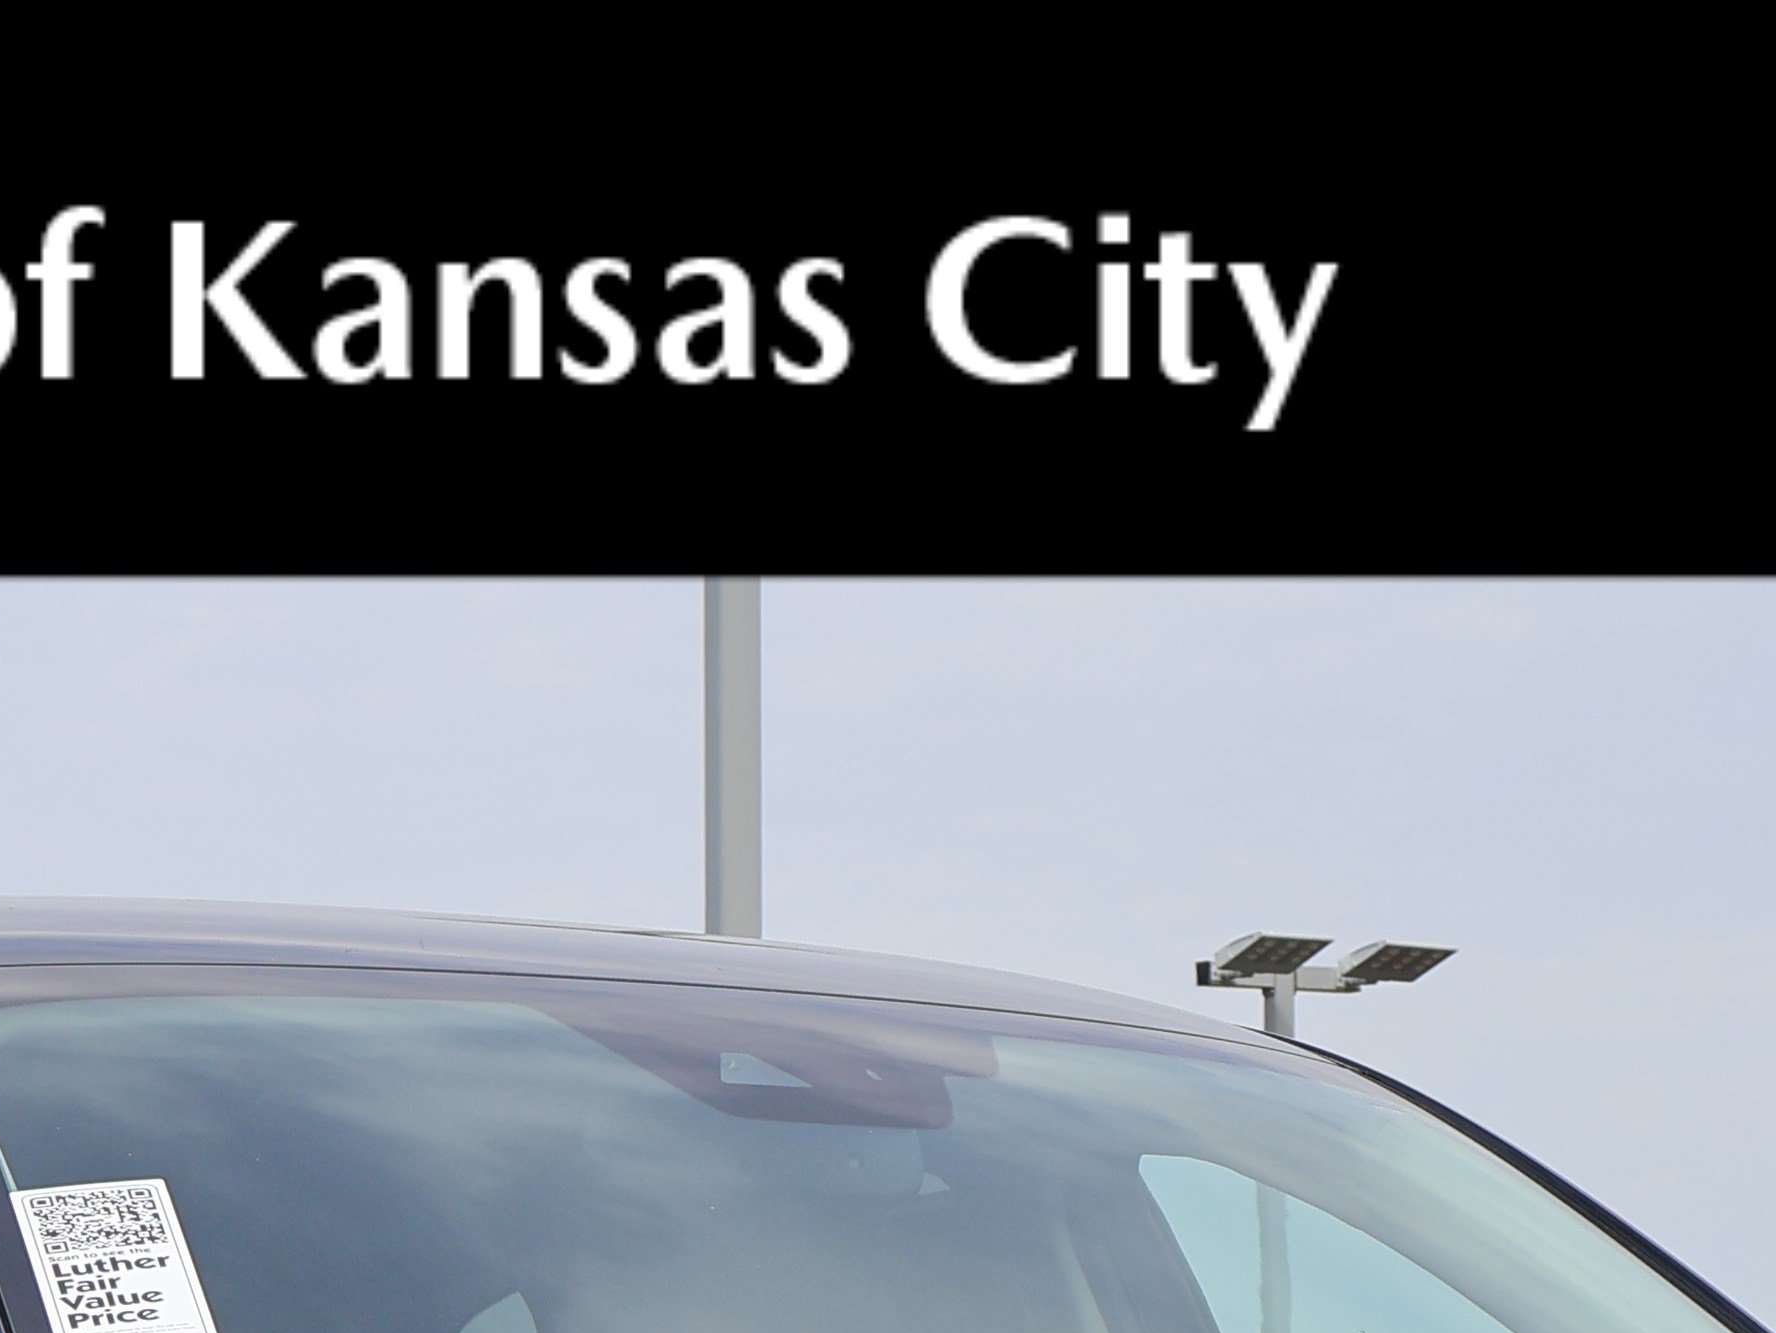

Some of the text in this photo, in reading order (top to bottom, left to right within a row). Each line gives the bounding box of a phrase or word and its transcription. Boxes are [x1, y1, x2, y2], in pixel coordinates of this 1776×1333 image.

[48, 1254, 79, 1263] Scan
[51, 1255, 170, 1278] Luther
[56, 1274, 121, 1295] Fair
[59, 1290, 165, 1311] Value
[67, 1308, 160, 1329] Price
